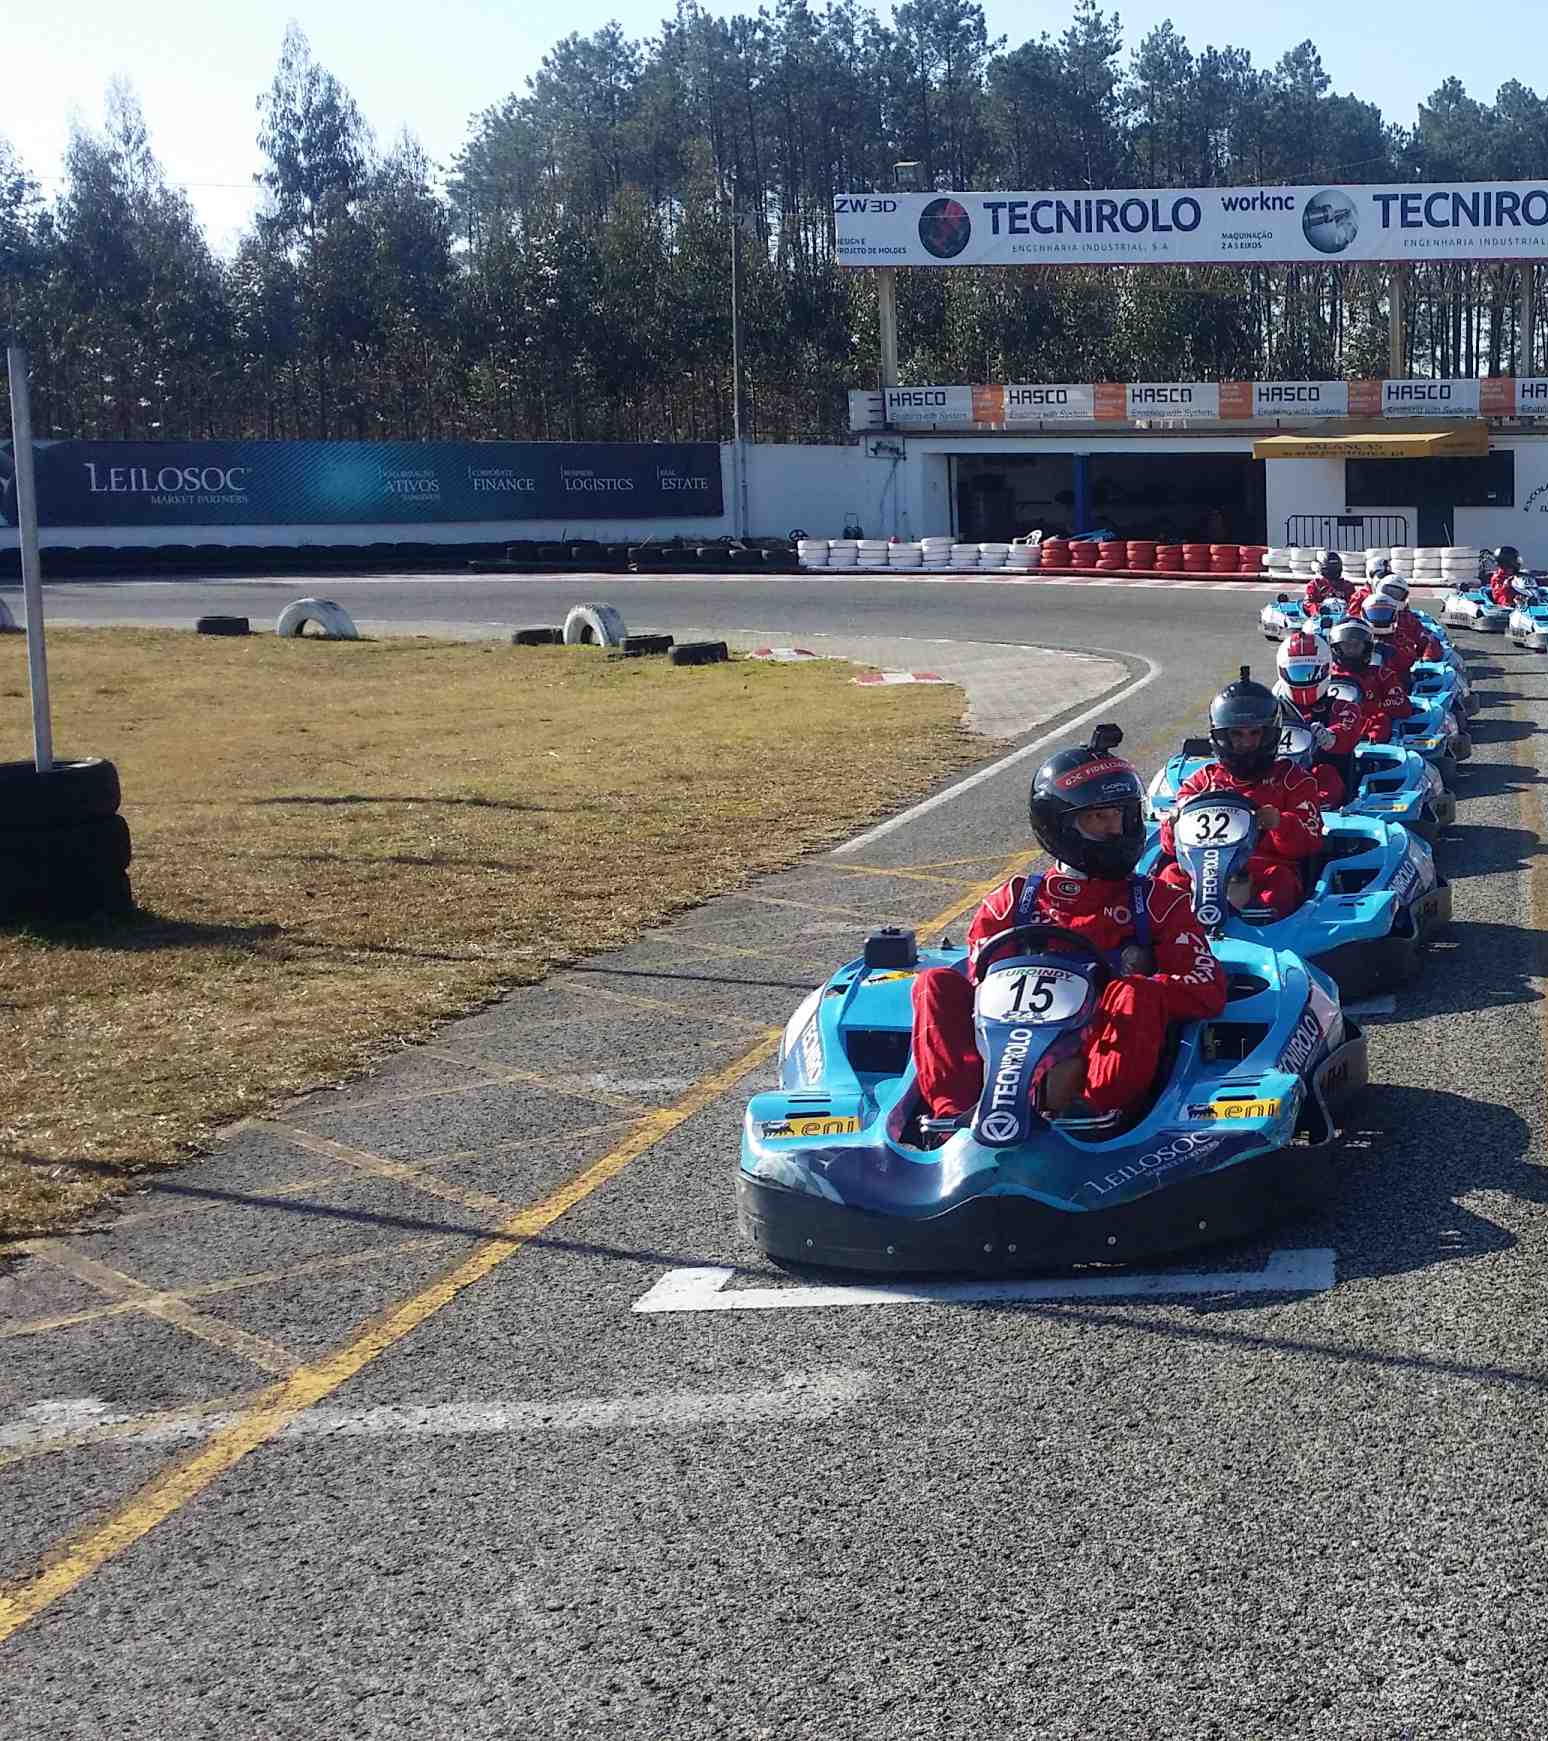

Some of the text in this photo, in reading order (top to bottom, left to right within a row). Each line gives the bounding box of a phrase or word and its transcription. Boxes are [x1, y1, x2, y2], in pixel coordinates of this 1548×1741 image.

[1221, 190, 1295, 212] worknc
[983, 197, 1201, 235] TECNIROLO
[1011, 243, 1079, 253] ENGENHARIA
[1403, 238, 1474, 248] ENGENHARIA
[889, 391, 946, 407] HASCO
[1008, 389, 1067, 404] HASCO
[1131, 387, 1191, 403] HASCO
[1258, 386, 1319, 402] HASCO
[1387, 384, 1450, 401] HASCO
[83, 462, 246, 492] LEILOSOC
[473, 478, 536, 491] FINANCE
[565, 478, 634, 490] LOGISTICS
[661, 478, 709, 489] ESTATE
[384, 479, 440, 492] ATIVOS
[1195, 812, 1231, 840] 32
[998, 968, 1074, 981] EUROINDY
[1009, 974, 1056, 1013] 15
[992, 1028, 1032, 1109] TECNIROLO
[1223, 1100, 1279, 1120] eni
[801, 1118, 854, 1136] eni
[1083, 1130, 1214, 1194] LEILOSOC
